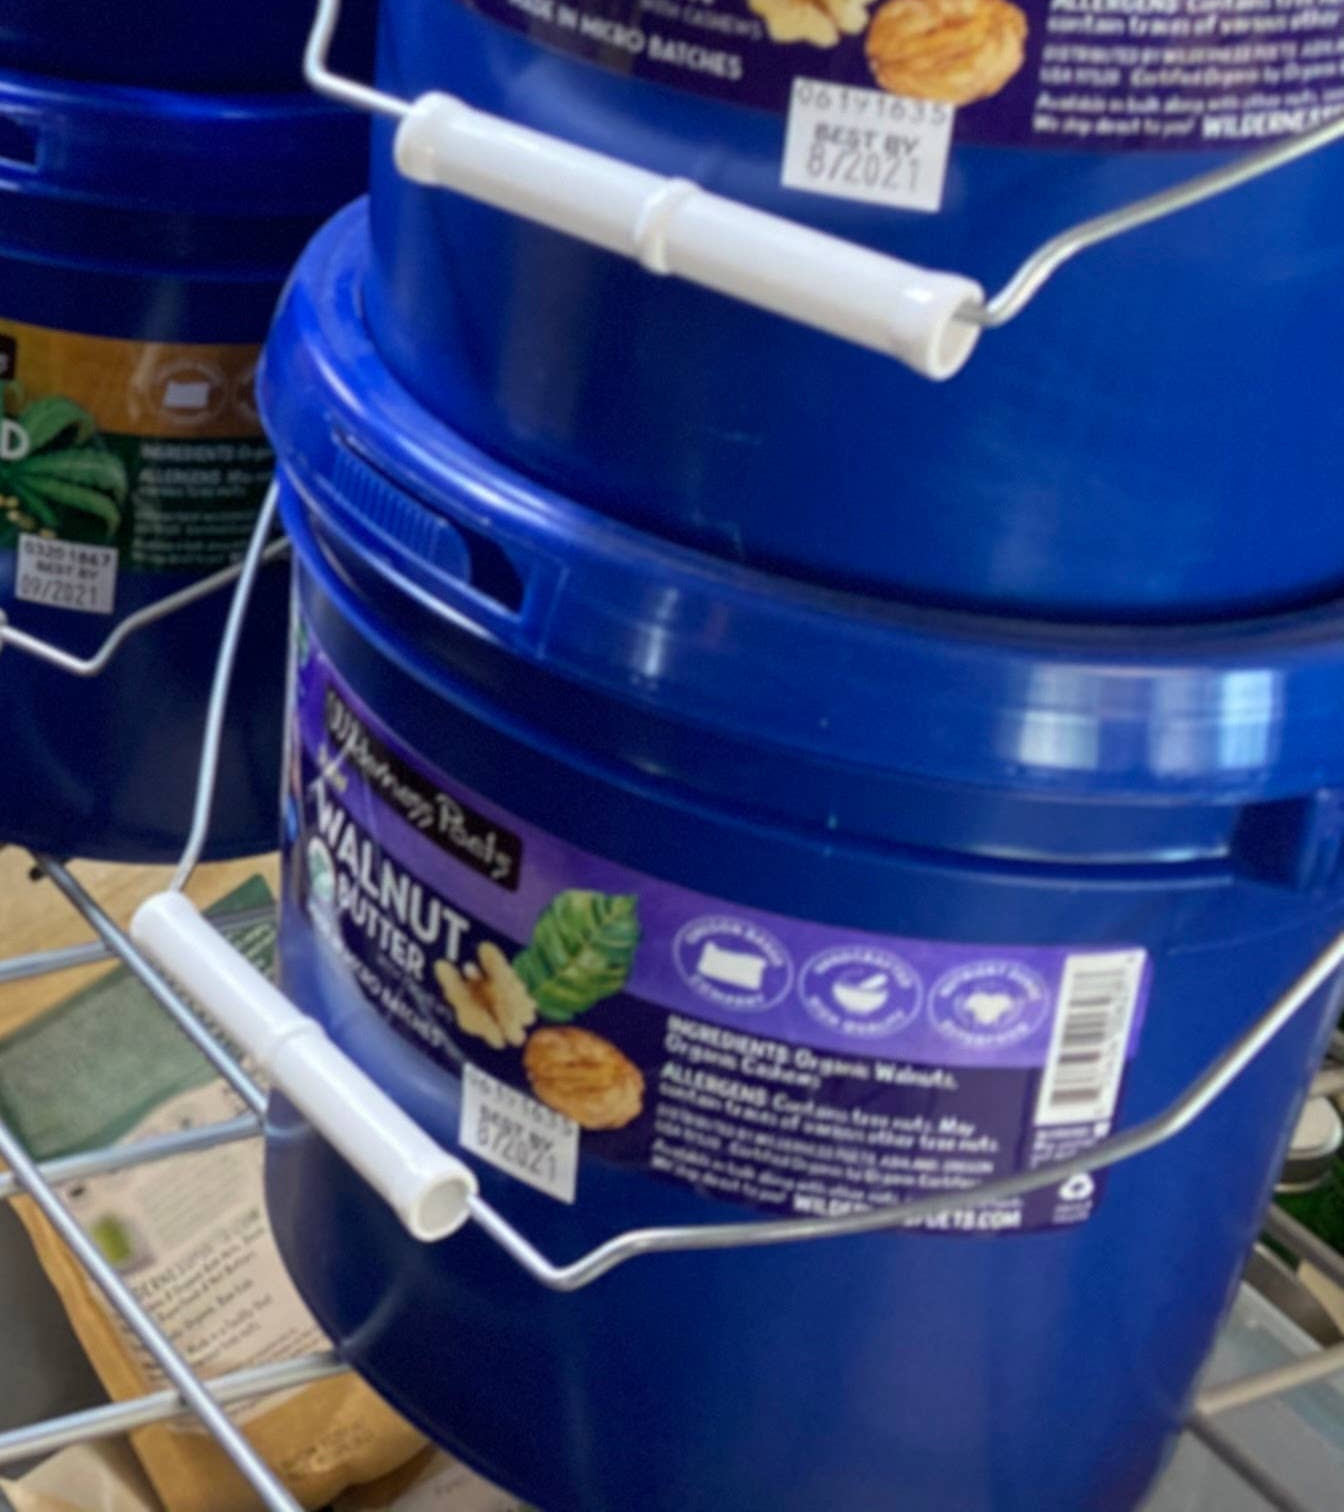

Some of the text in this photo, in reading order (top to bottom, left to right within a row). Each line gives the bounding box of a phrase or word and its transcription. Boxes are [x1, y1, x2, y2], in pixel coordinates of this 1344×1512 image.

[557, 5, 578, 29] IN
[578, 13, 645, 55] MICRO
[647, 34, 744, 82] BATCHES
[813, 122, 920, 158] BEST BY
[805, 143, 921, 194] 8/2021
[325, 690, 513, 880] Wilderness Poets
[315, 778, 470, 963] WALNUT
[338, 872, 427, 982] BUTTER
[664, 1033, 738, 1070] Organic
[794, 1046, 869, 1079] Organic
[938, 1116, 976, 1137] May
